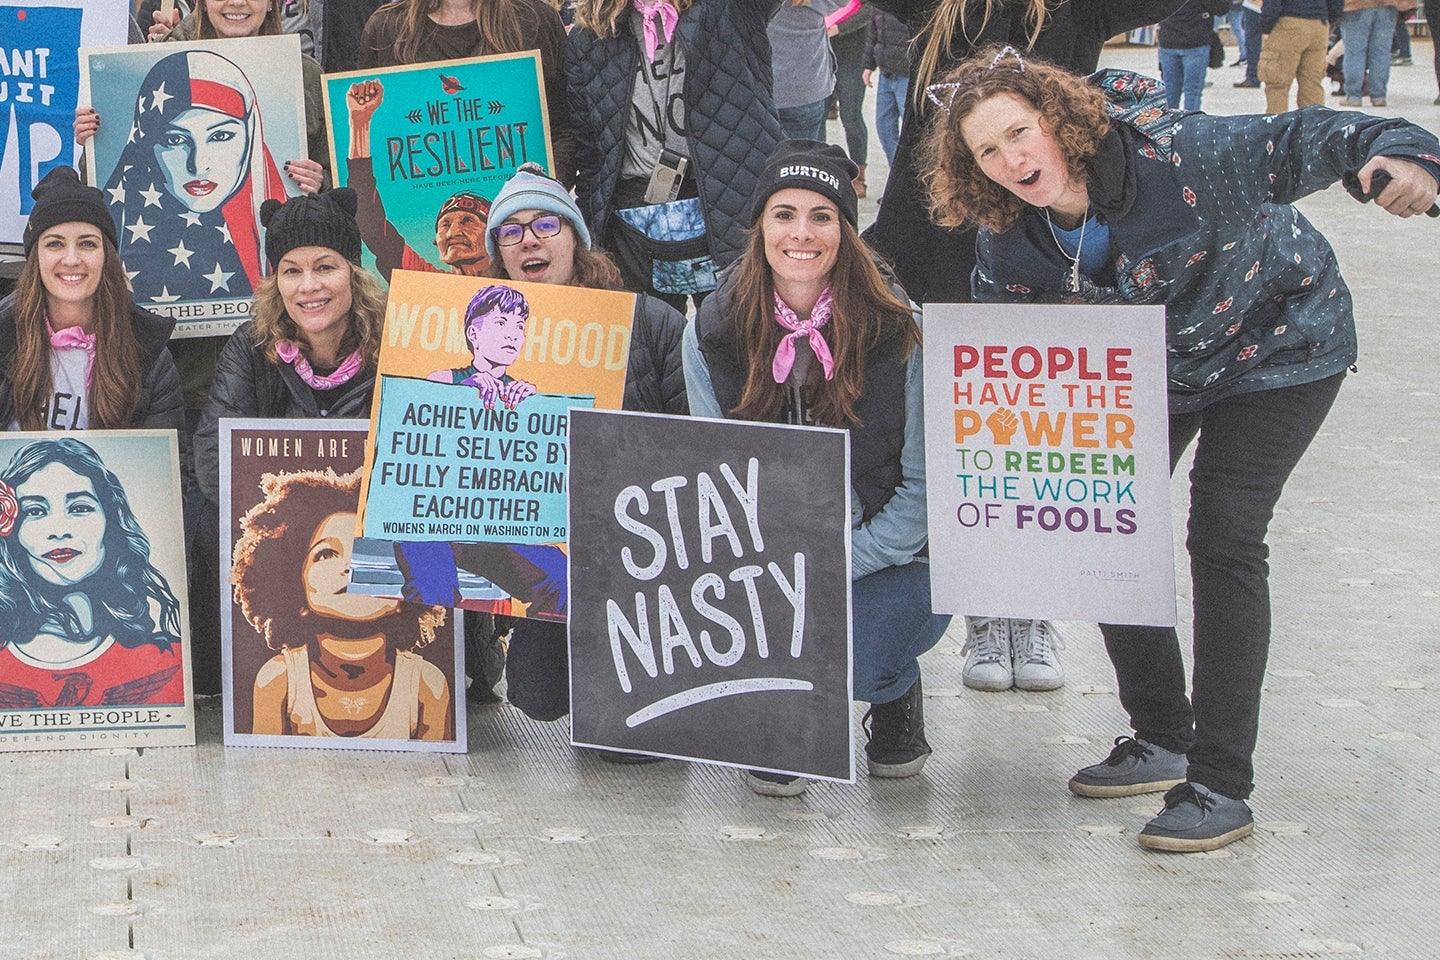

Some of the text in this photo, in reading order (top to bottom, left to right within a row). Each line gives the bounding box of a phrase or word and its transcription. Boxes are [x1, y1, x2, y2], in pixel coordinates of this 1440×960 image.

[426, 97, 484, 126] WE THE
[387, 122, 528, 181] RESILIENT
[459, 177, 481, 185] HERE
[780, 165, 840, 190] BURTON
[165, 305, 205, 317] THE
[211, 302, 250, 314] PEO
[953, 345, 1133, 381] PEOPLE
[953, 382, 1133, 409] HAVE THE
[402, 403, 568, 436] ACHIEVING OUR
[241, 437, 302, 456] WOMEN
[318, 438, 348, 457] ARE
[391, 432, 446, 457] FULL
[456, 436, 538, 462] SELVES
[956, 449, 1135, 476] TO REDEEM
[381, 462, 567, 494] FULLY EMBRACIN
[956, 475, 1136, 504] THE WORK
[412, 495, 540, 522] EACHOTHER
[614, 456, 765, 581] STAY
[957, 502, 1137, 534] OF FOOLS
[383, 522, 566, 538] WOMENS MARCH ON WASHINGTON 20
[1110, 571, 1139, 579] SMITH
[606, 552, 806, 693] NASTY
[30, 712, 71, 726] THE
[80, 710, 160, 725] PEOPLE
[0, 731, 151, 743] DEFEND DIGNITY
